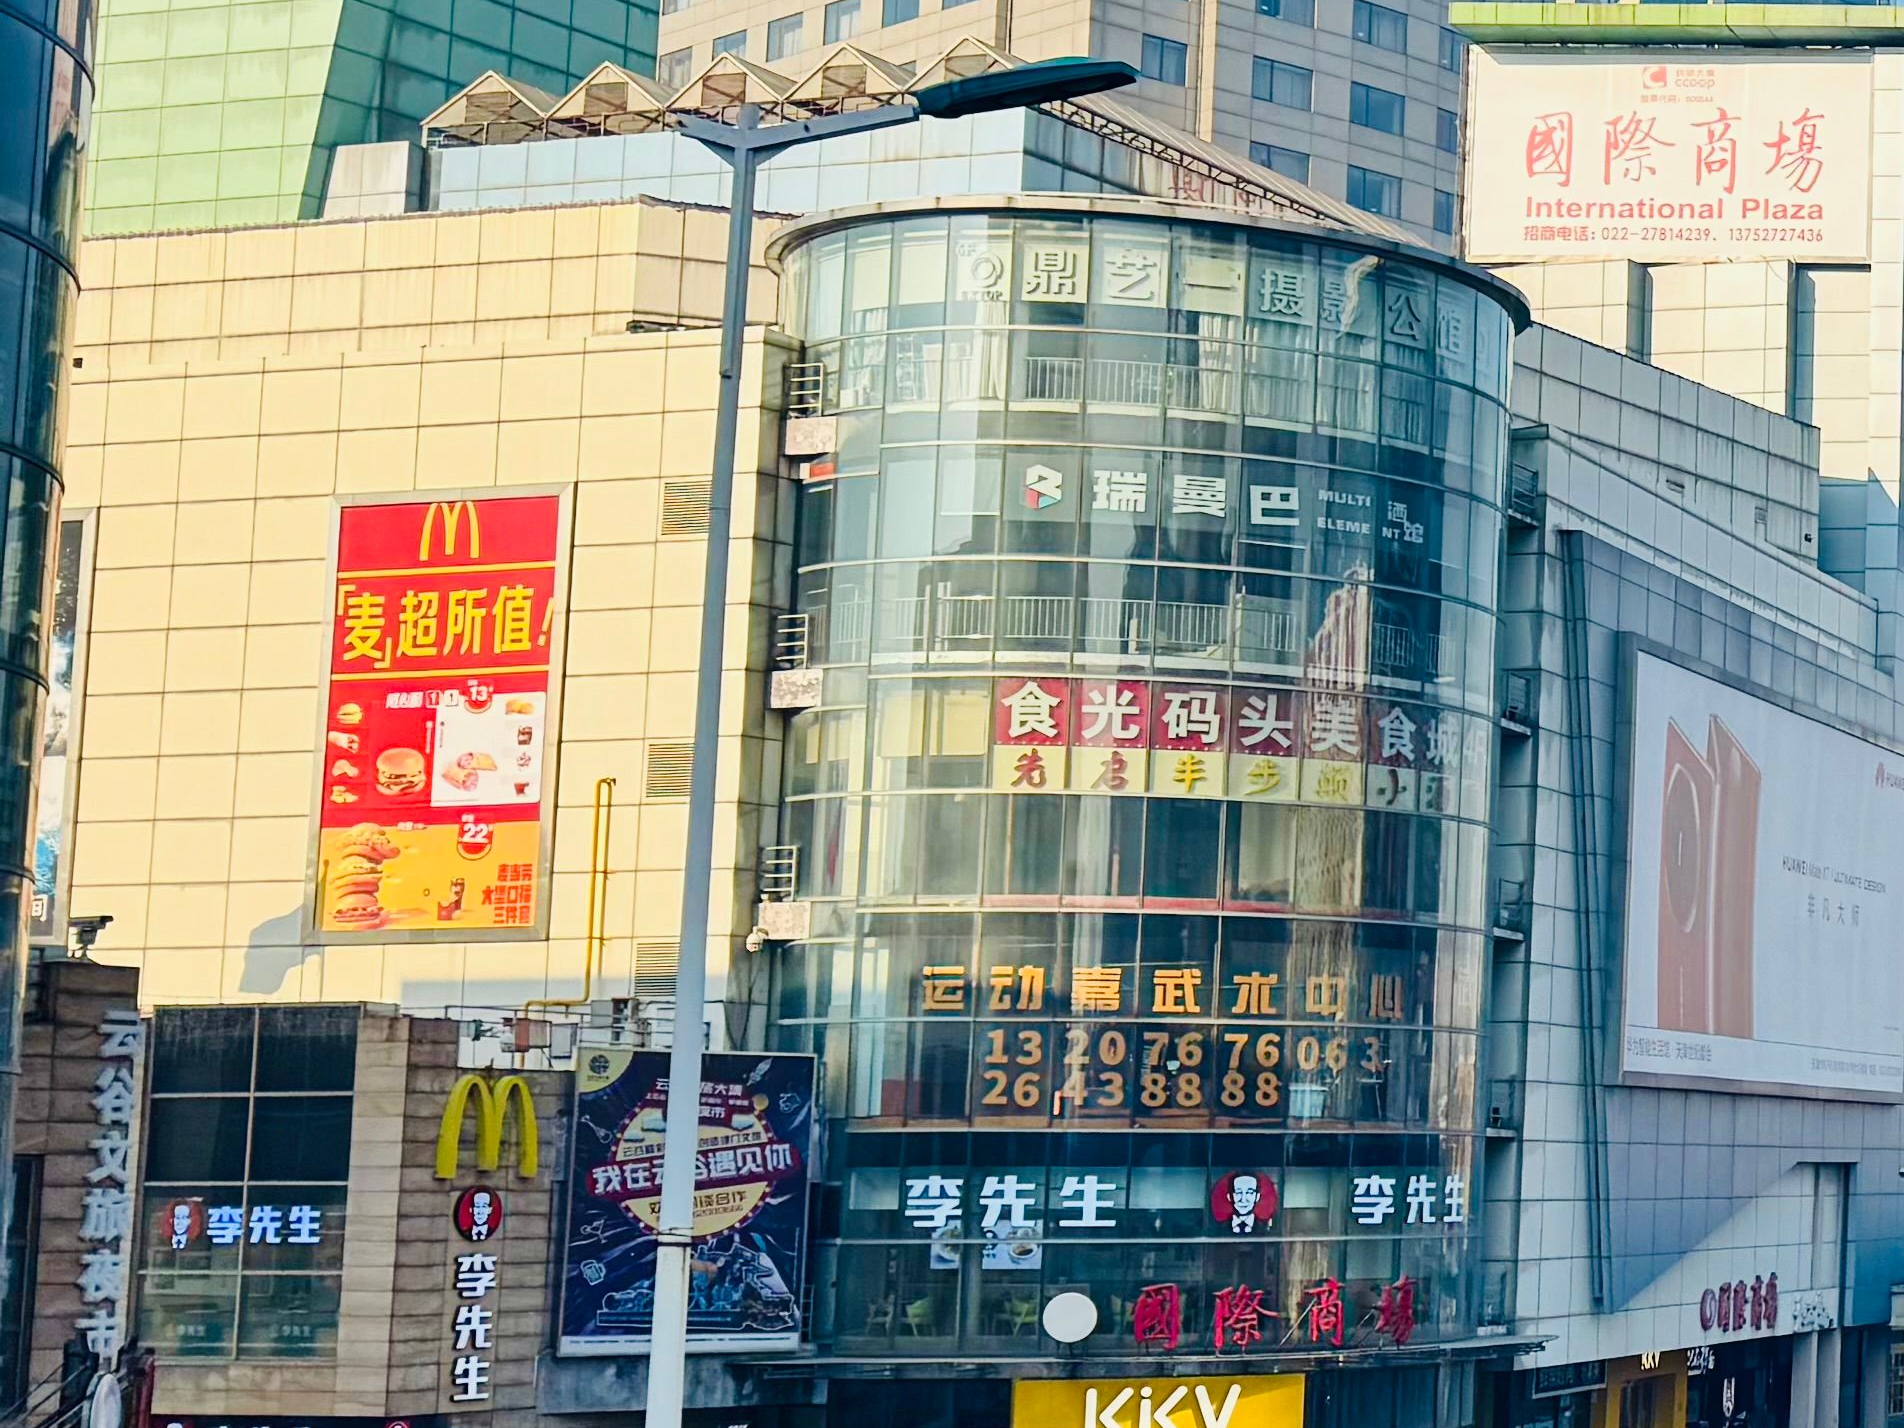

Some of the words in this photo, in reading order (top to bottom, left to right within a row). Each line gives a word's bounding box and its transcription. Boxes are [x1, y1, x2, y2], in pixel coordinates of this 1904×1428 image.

[1525, 197, 1723, 220] International
[1741, 198, 1824, 221] Plaza
[1092, 469, 1300, 527] 瑞曼巴
[1318, 488, 1372, 508] MULTI
[206, 1205, 321, 1244] 李先生
[904, 1174, 1118, 1228] 李先生
[1350, 1174, 1465, 1225] 李先生
[452, 1252, 499, 1403] 李先生
